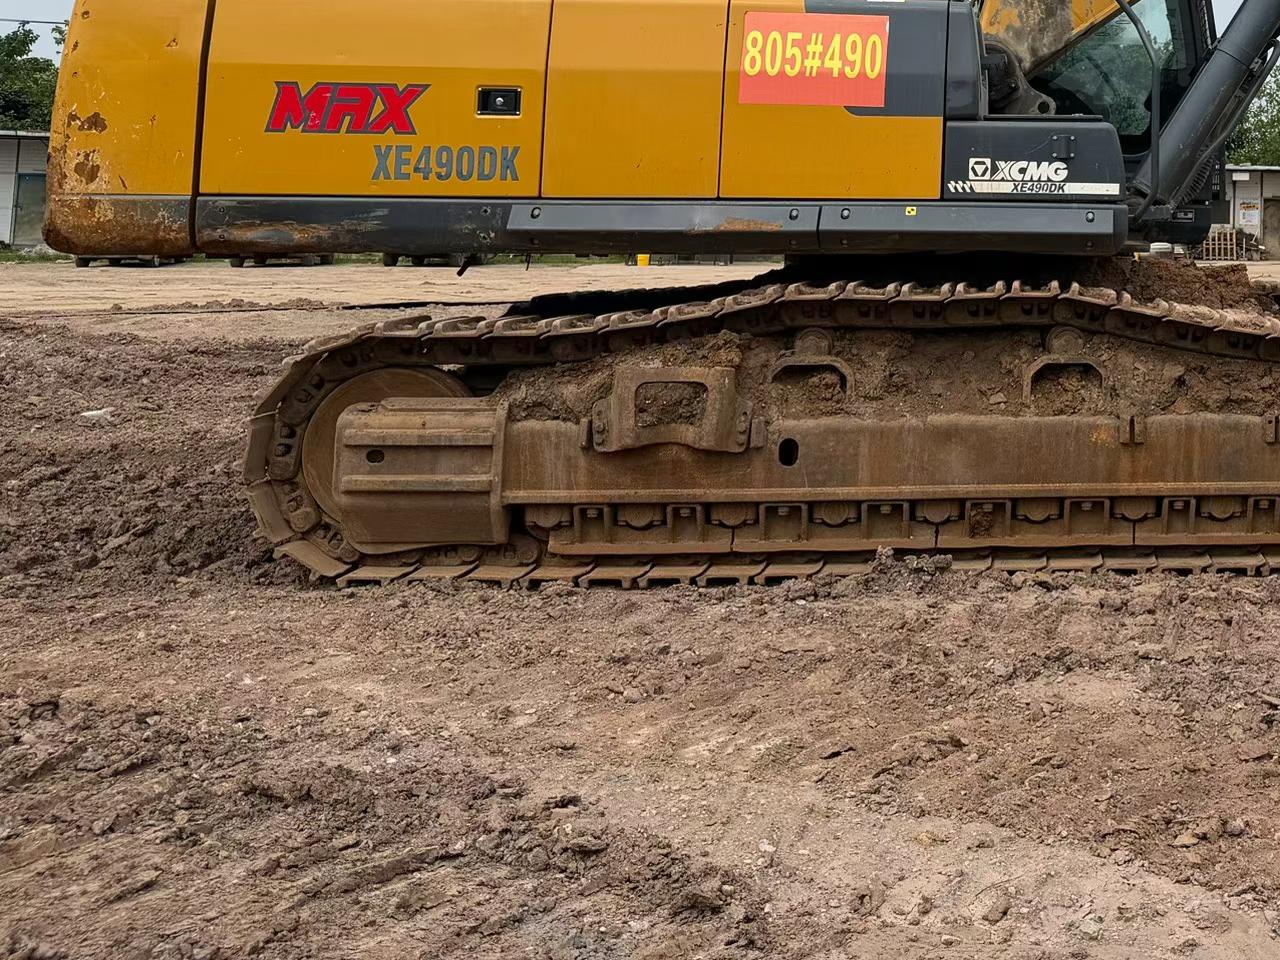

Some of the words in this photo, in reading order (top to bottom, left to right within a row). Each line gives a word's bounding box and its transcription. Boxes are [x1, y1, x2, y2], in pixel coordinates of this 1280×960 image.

[743, 30, 882, 79] 805#490
[264, 81, 432, 135] MAX
[371, 144, 521, 181] XE490DK
[991, 160, 1069, 182] XCMG
[1011, 182, 1067, 193] XE490DK
